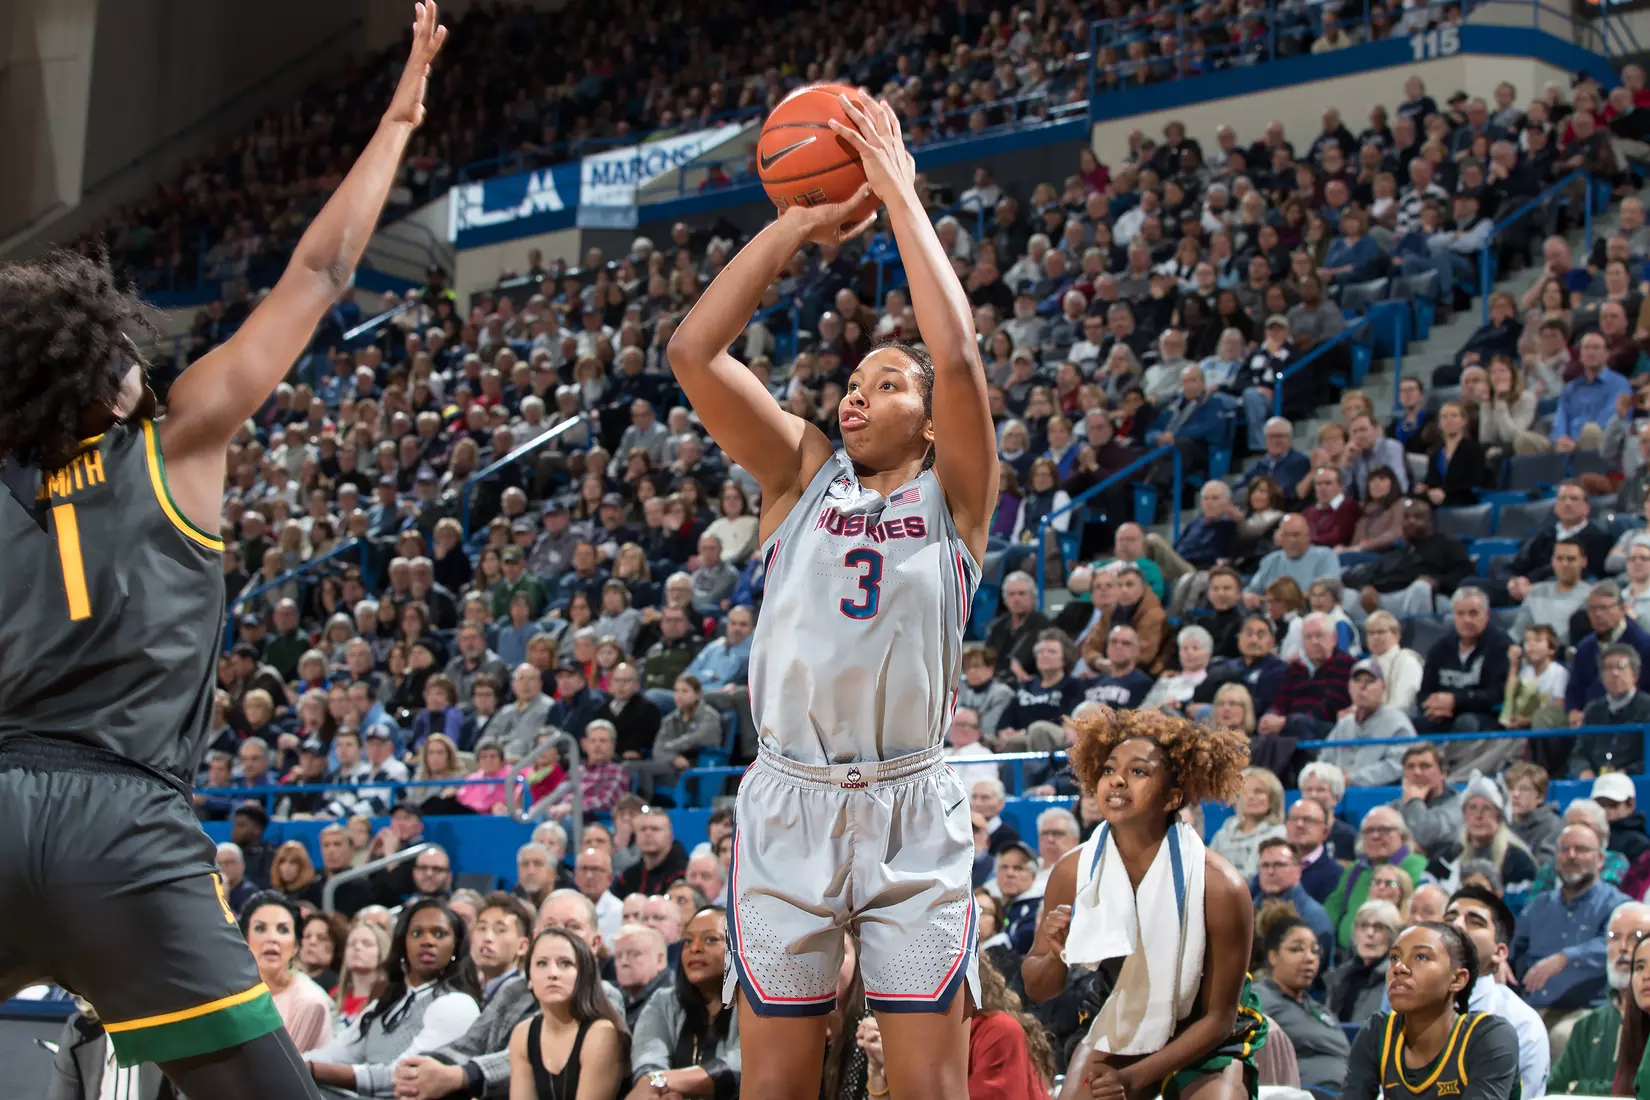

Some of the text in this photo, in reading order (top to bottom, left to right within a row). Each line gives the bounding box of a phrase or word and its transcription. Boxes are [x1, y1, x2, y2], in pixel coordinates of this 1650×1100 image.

[1410, 27, 1461, 60] 115
[814, 507, 927, 543] HUSKIES
[53, 503, 91, 620] 1
[840, 548, 883, 620] 3
[840, 781, 868, 789] UCONN
[1439, 1082, 1458, 1094] XII
